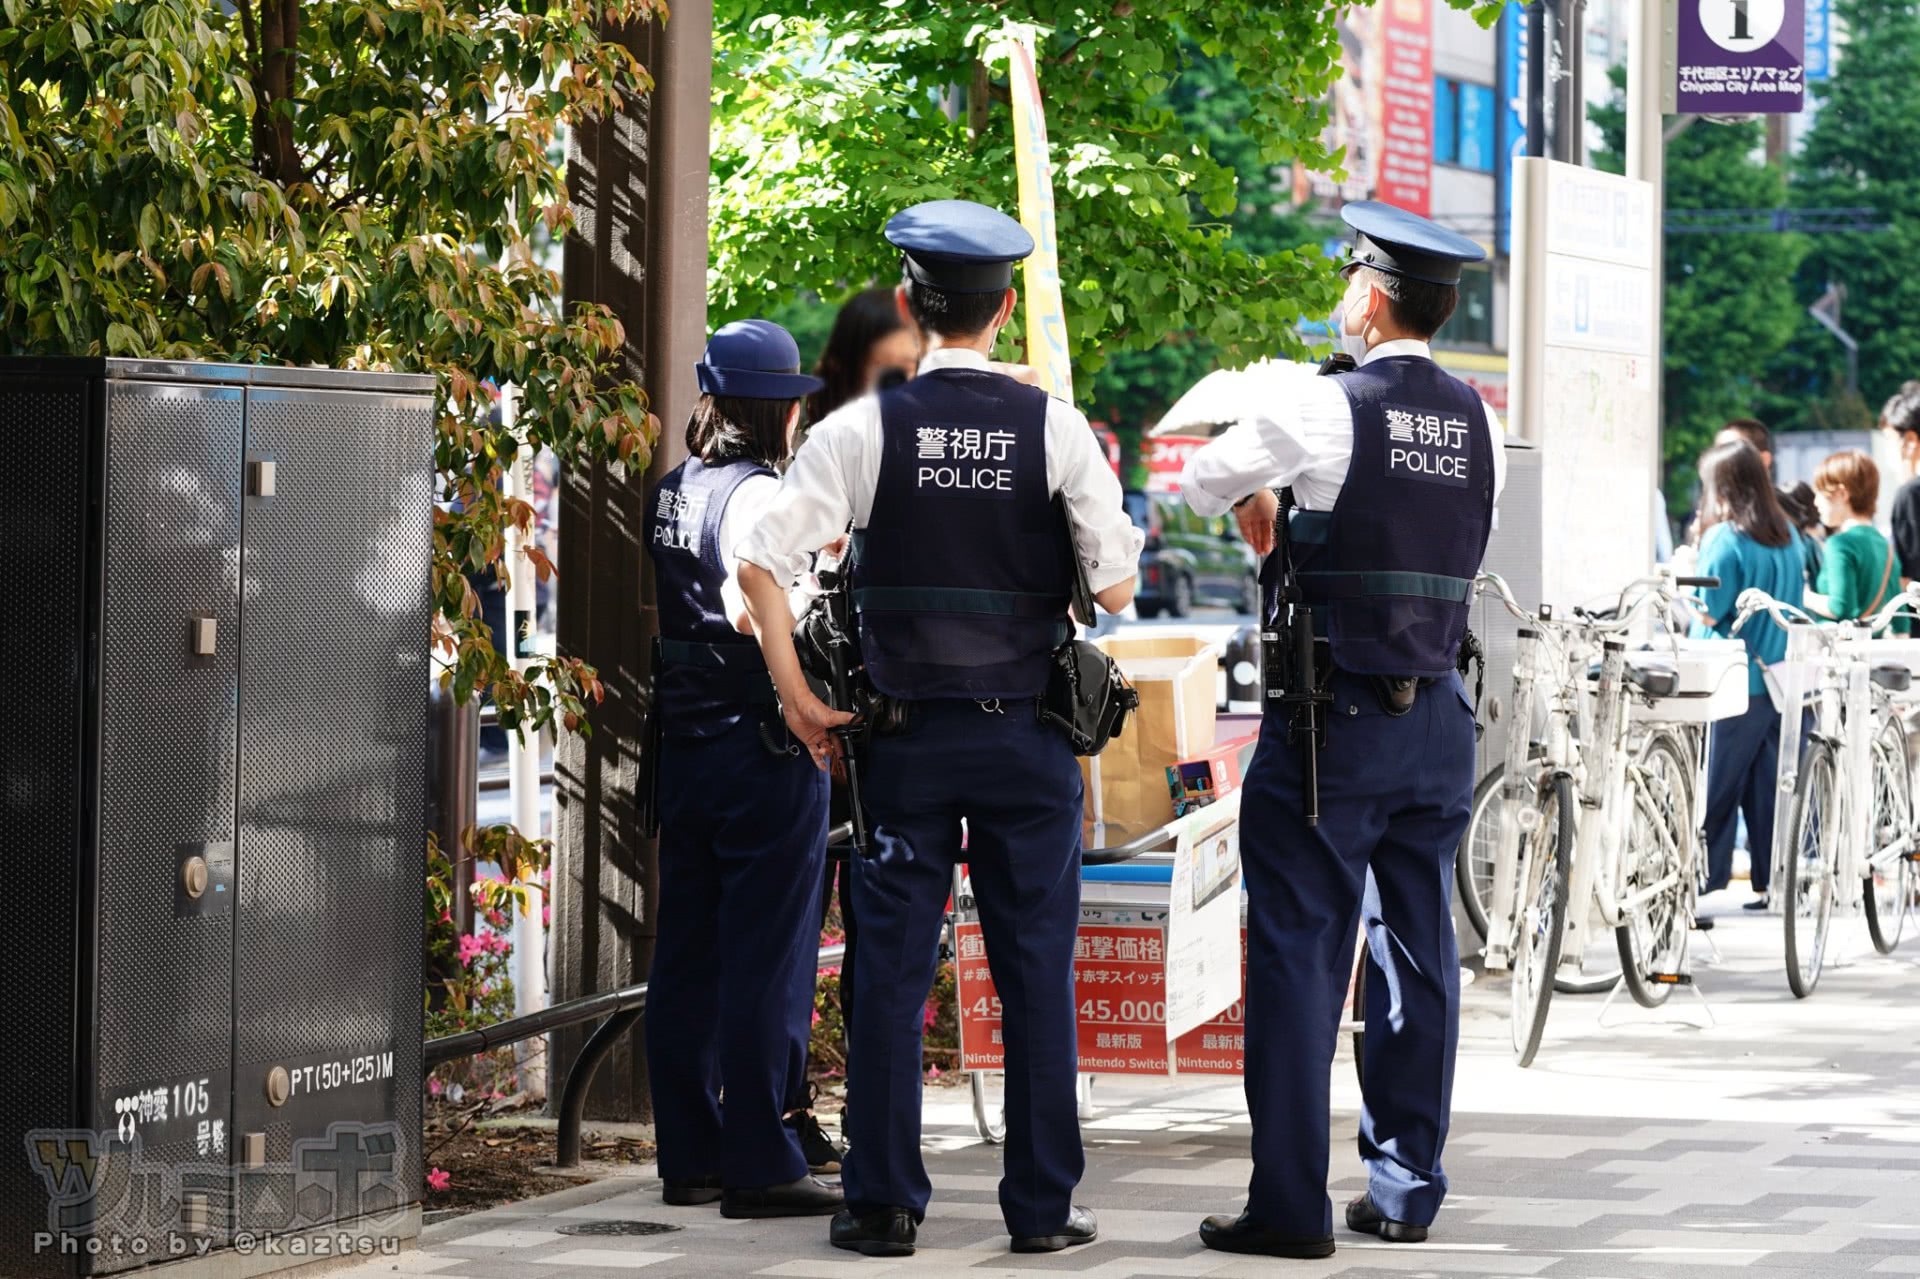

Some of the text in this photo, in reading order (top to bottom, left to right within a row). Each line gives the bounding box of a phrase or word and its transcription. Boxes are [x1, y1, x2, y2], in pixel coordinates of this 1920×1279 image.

[1679, 65, 1803, 81] 千代田区エリアマップ
[1679, 81, 1803, 94] Chiyoda City Area Map
[1385, 409, 1468, 449] 警視庁
[916, 427, 1016, 461] 警視庁
[1390, 448, 1468, 479] POLICE
[918, 467, 1013, 491] POLICE
[656, 488, 706, 523] 警視庁
[653, 525, 700, 552] POLICE
[1096, 1033, 1143, 1049] 最新版
[291, 1051, 394, 1096] PT(50+125)M
[1129, 1058, 1168, 1070] Switch
[1178, 1057, 1233, 1069] Nintendo
